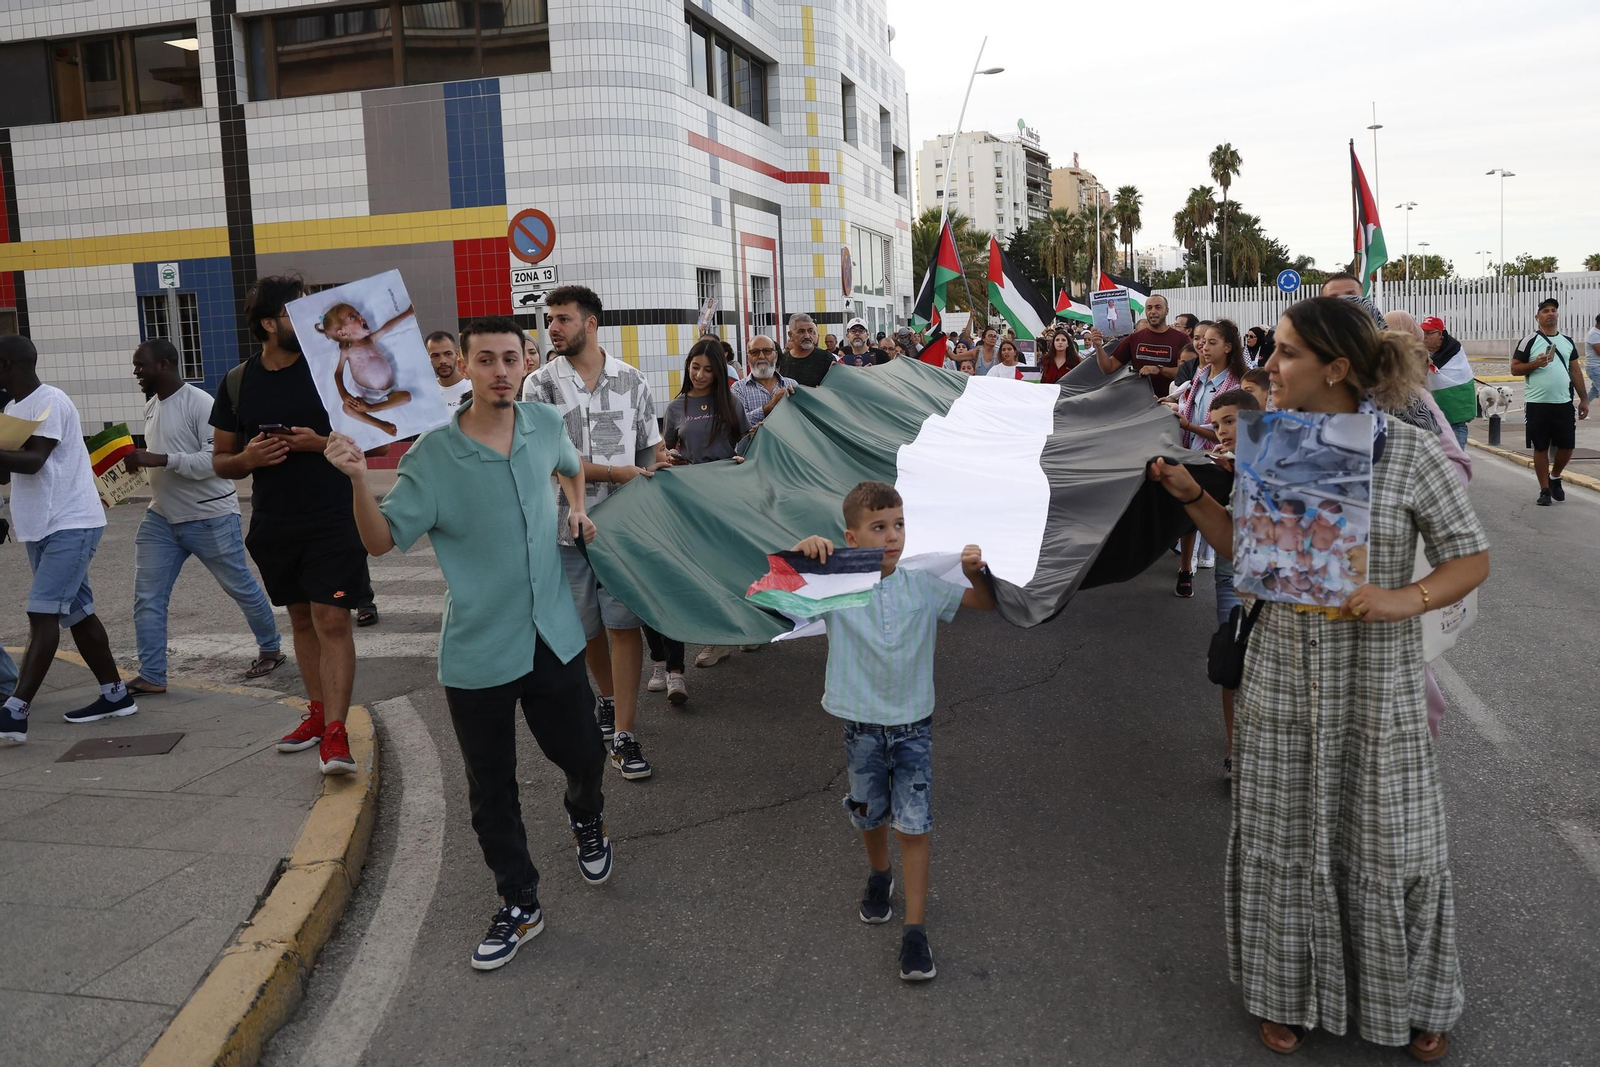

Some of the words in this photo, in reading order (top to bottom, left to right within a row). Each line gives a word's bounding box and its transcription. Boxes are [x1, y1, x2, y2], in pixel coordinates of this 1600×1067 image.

[514, 271, 539, 283] ZONA
[543, 270, 552, 280] 13
[1139, 346, 1169, 355] Champion
